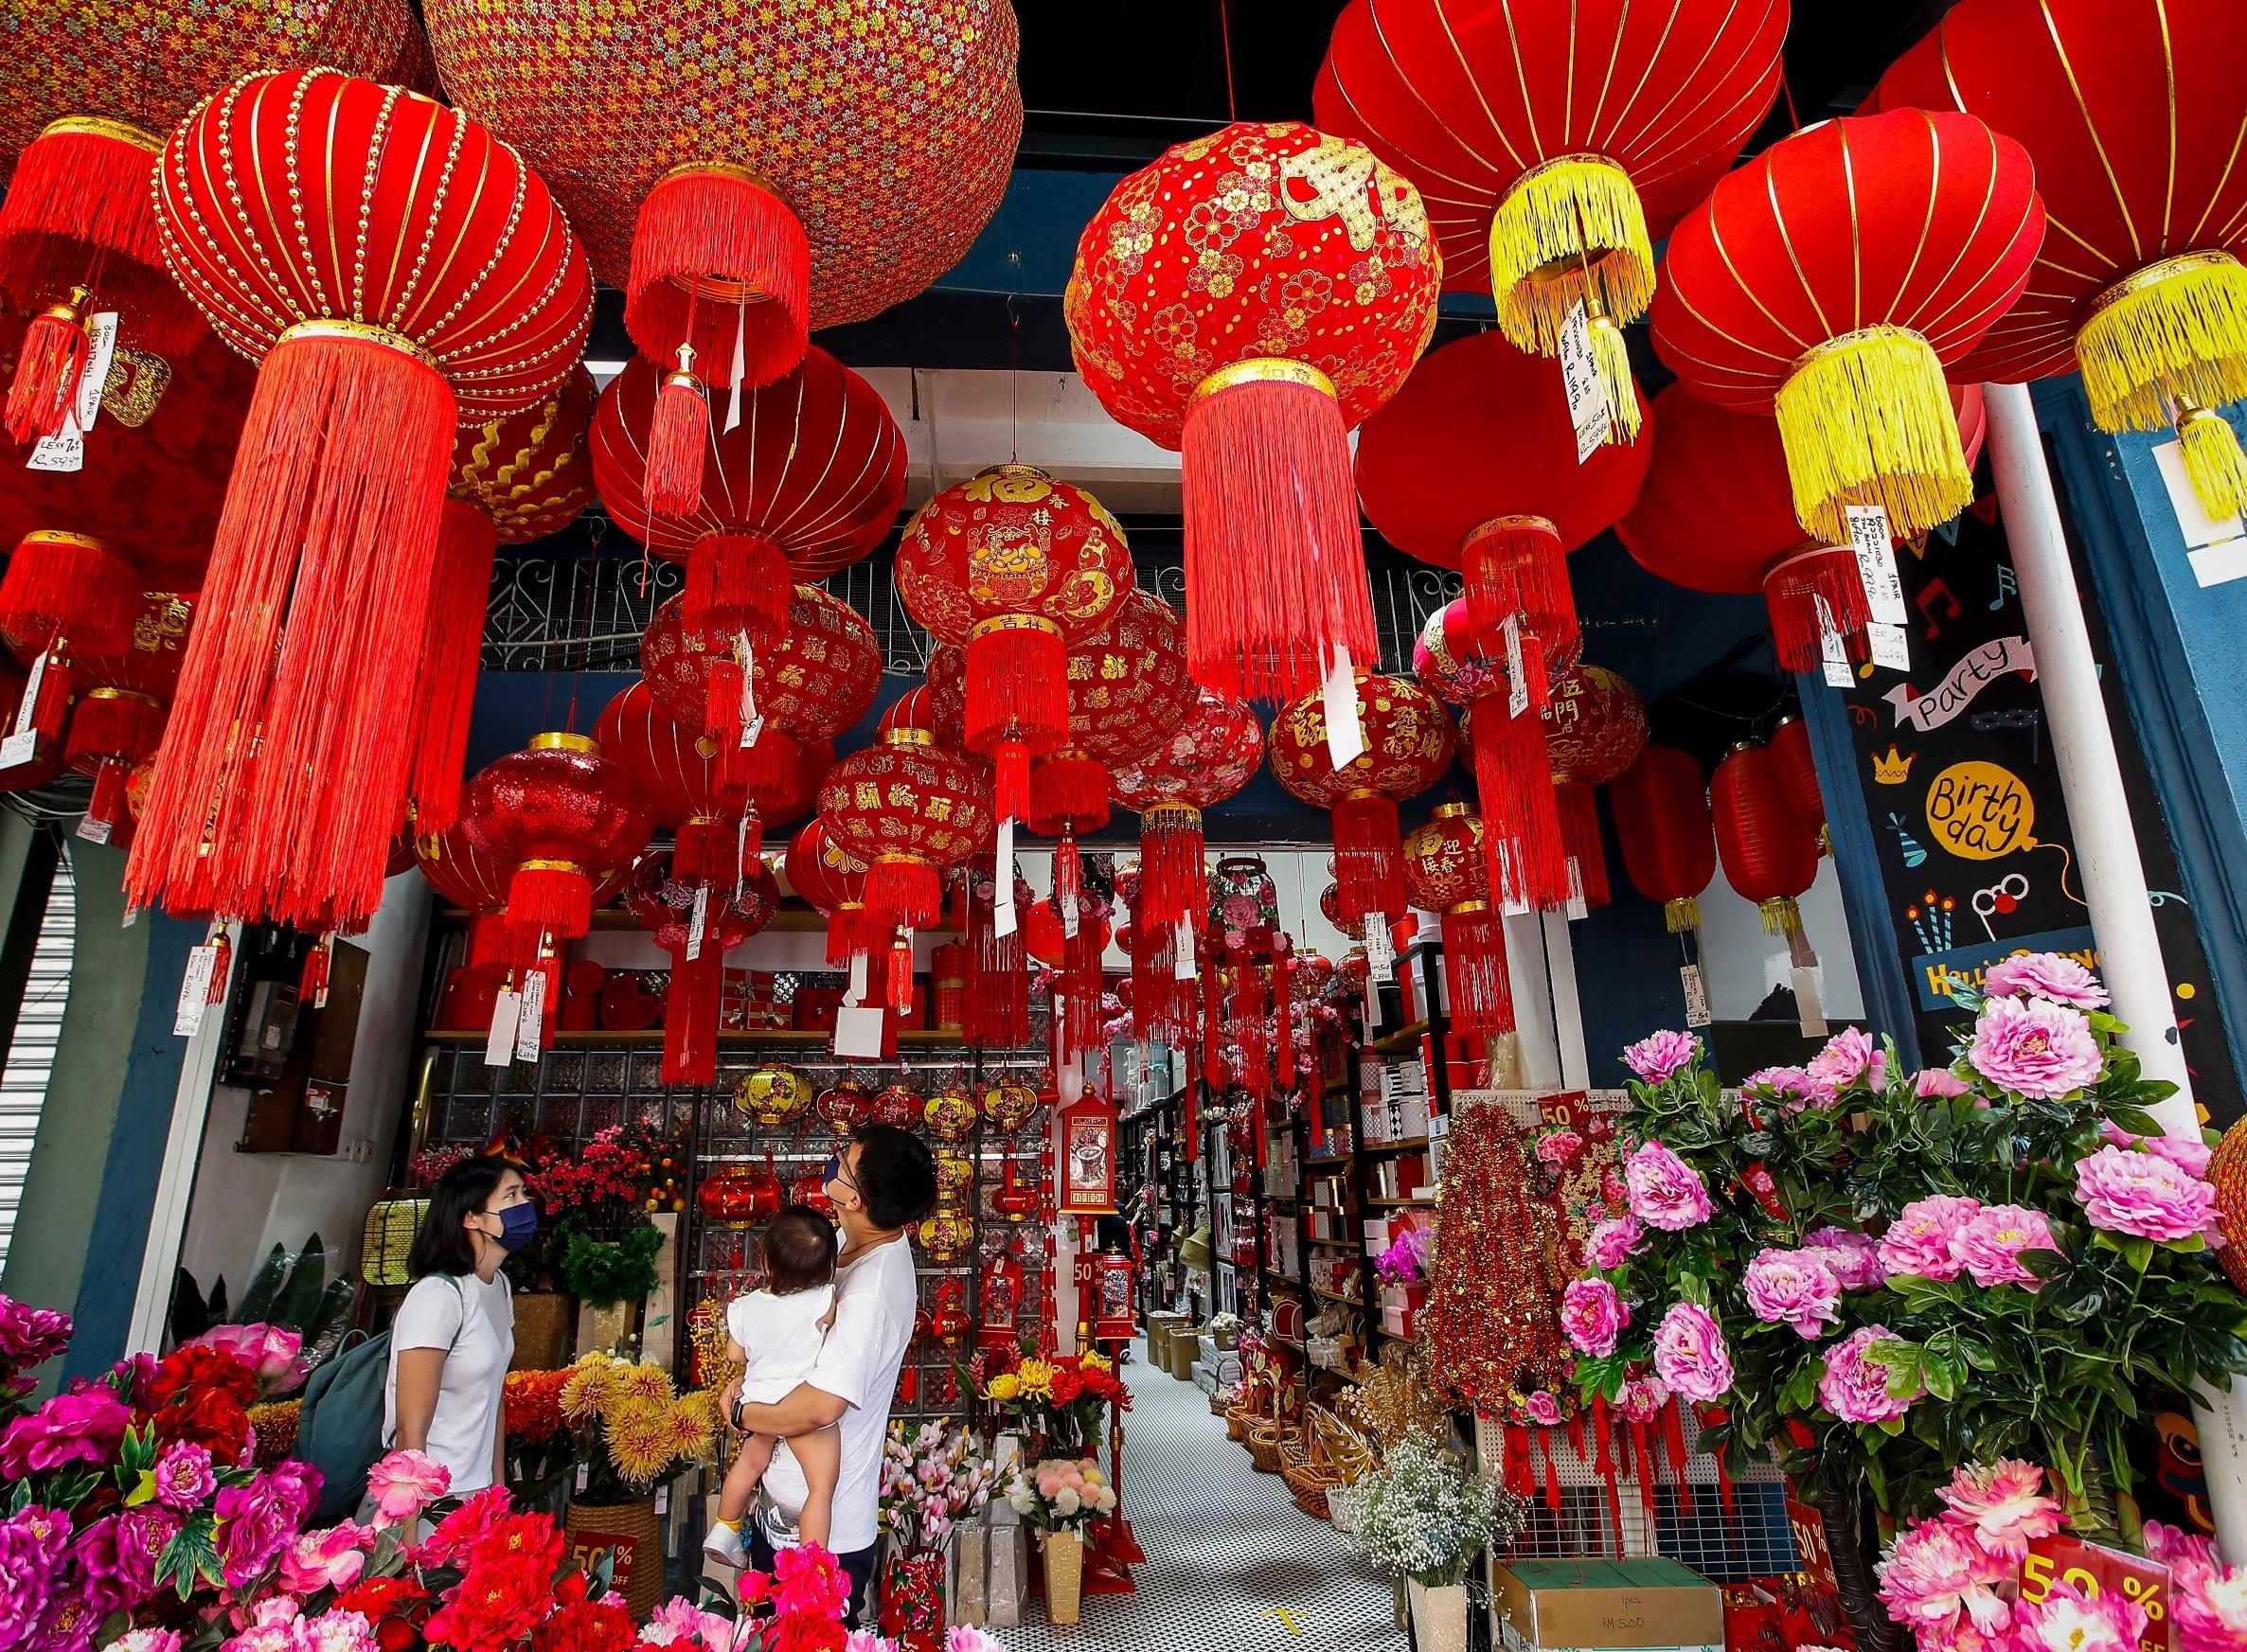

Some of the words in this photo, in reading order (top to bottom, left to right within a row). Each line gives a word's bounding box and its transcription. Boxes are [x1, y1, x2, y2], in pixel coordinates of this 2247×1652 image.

[40, 441, 64, 450] LESS
[1929, 774, 2022, 823] Birth
[1946, 811, 2021, 853] day
[1541, 1105, 1572, 1127] 50
[1574, 1097, 1590, 1113] %
[1074, 1263, 1092, 1281] 50
[1095, 1260, 1104, 1272] %
[1792, 1519, 1817, 1565] 50
[1811, 1522, 1828, 1553] %
[615, 1545, 633, 1565] %
[611, 1574, 630, 1586] OFF
[2123, 1575, 2165, 1622] %
[1602, 1617, 1615, 1630] RM
